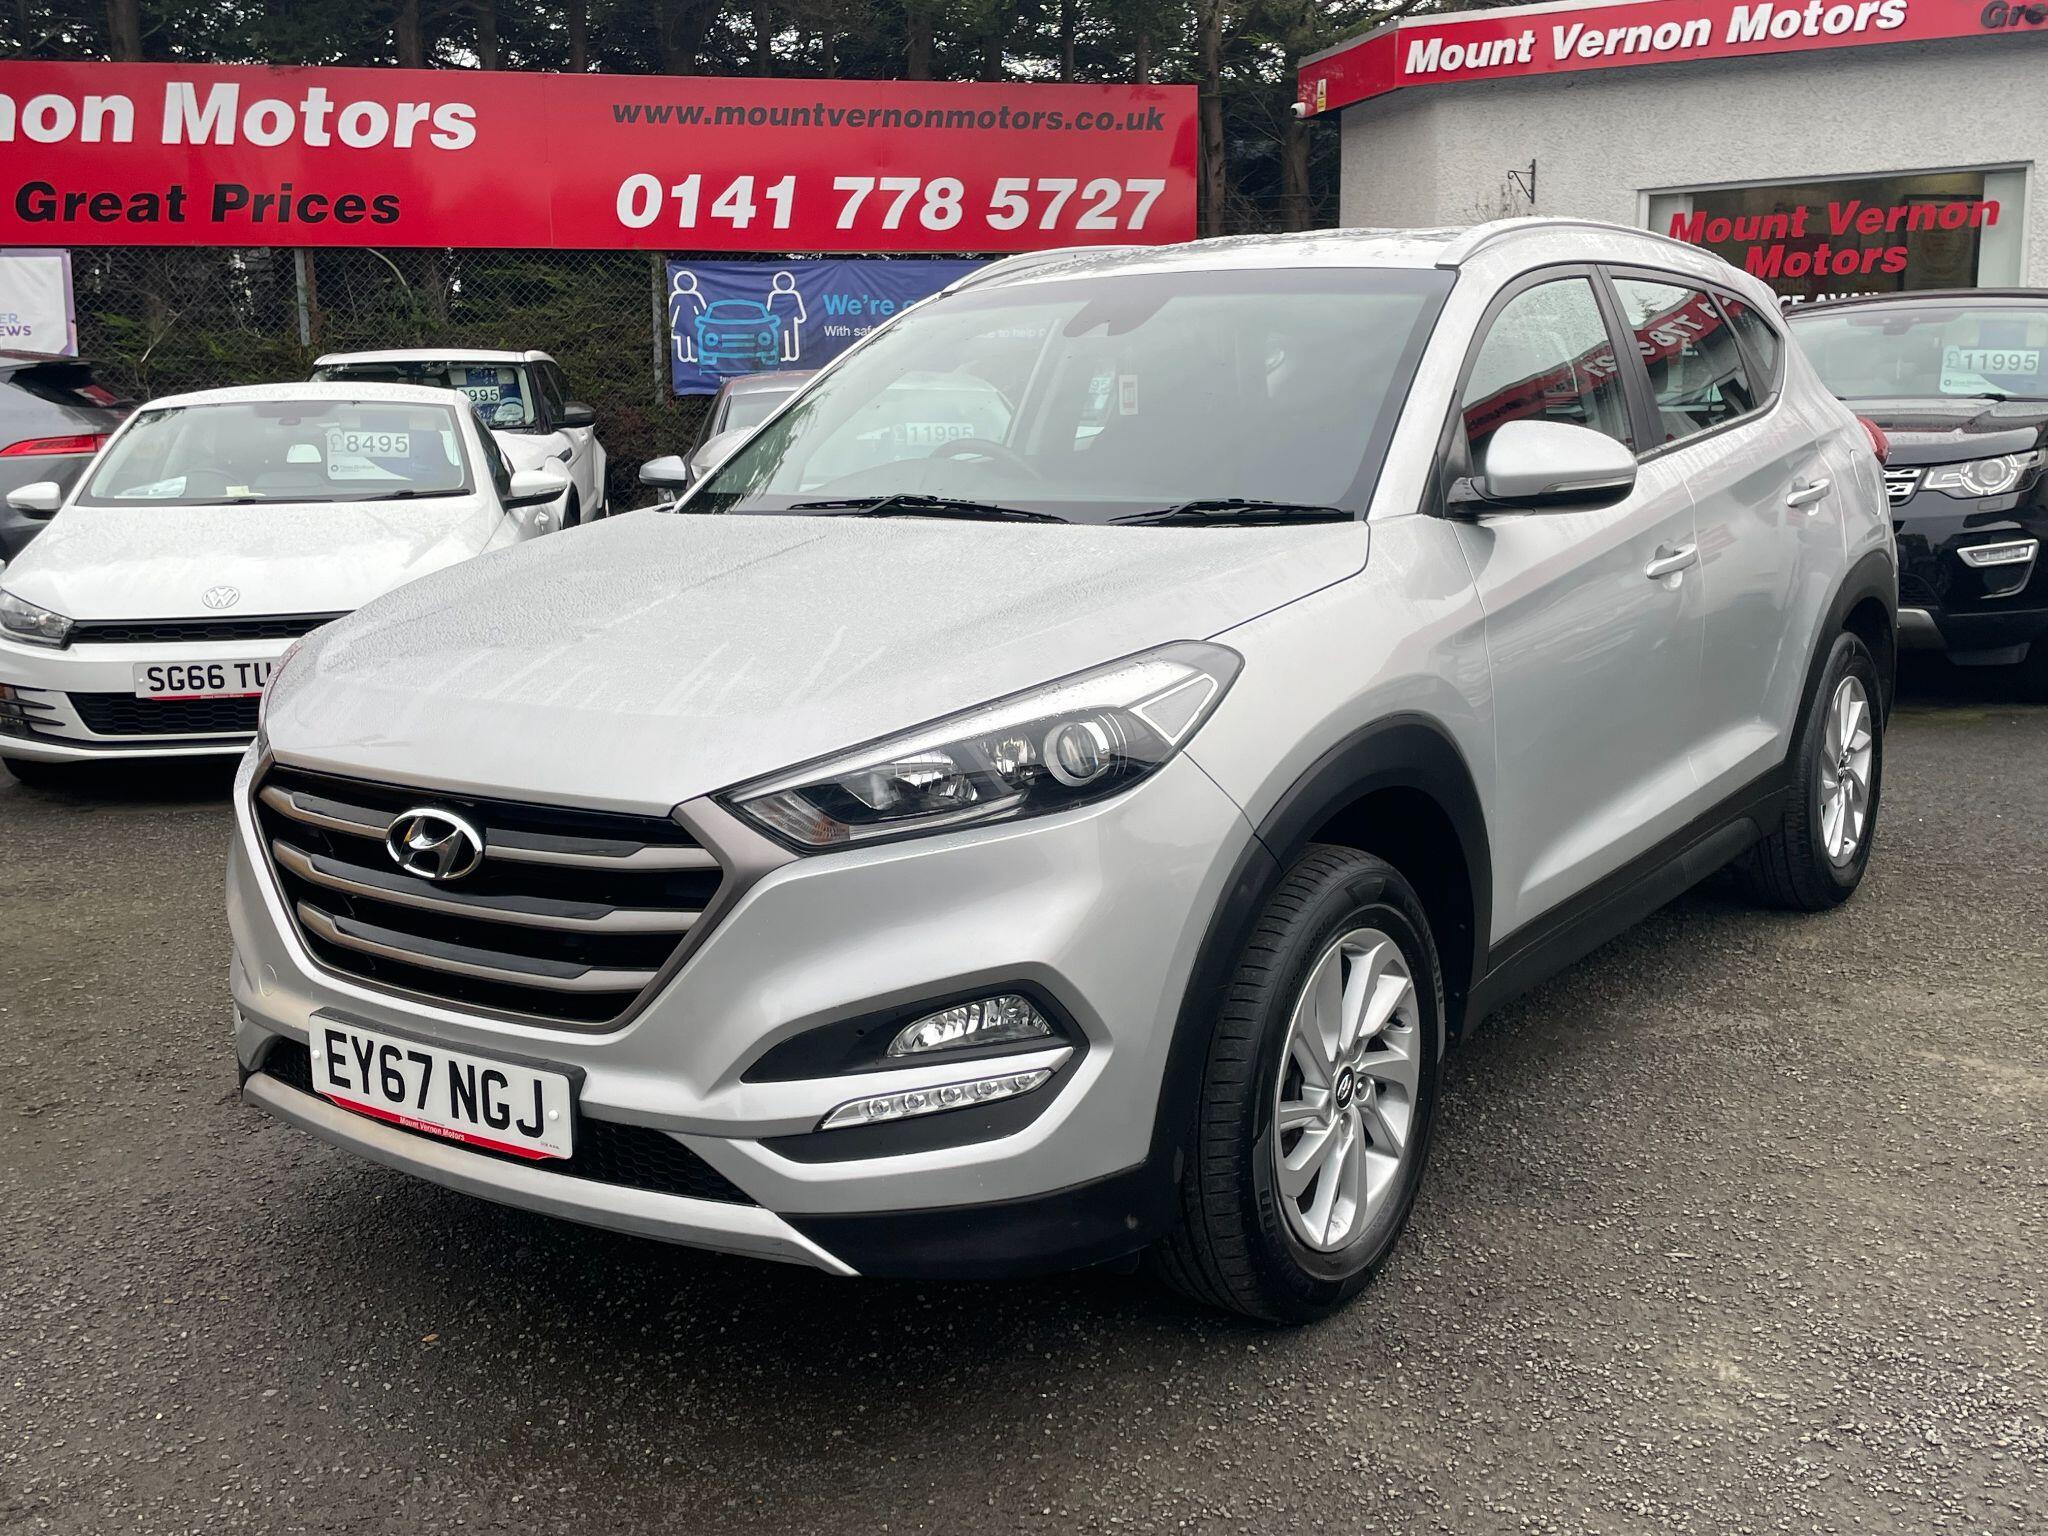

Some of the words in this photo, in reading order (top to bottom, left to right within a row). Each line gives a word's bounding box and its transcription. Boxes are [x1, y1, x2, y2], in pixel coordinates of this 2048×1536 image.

[1404, 29, 1535, 75] Mount
[1551, 17, 1713, 61] Vernon
[1725, 0, 1907, 44] Motors
[161, 81, 477, 150] Motors
[612, 102, 1166, 132] www.mountvernonmotors.co.uk
[15, 181, 187, 223] Great
[211, 183, 400, 224] Prices
[616, 173, 796, 229] 0141
[833, 176, 965, 231] 778
[985, 177, 1167, 231] 5727
[1668, 204, 1809, 245] Mount
[1826, 199, 2001, 236] Vernon
[1744, 243, 1908, 280] Motors
[824, 325, 852, 337] With
[1945, 351, 2038, 371] £11995
[461, 389, 499, 402] 995
[147, 664, 225, 692] SG66
[324, 1028, 433, 1110] EY67
[447, 1059, 545, 1139] NGJ
[399, 1116, 419, 1130] Mount
[420, 1121, 442, 1135] Vernon
[442, 1127, 465, 1141] Motors
